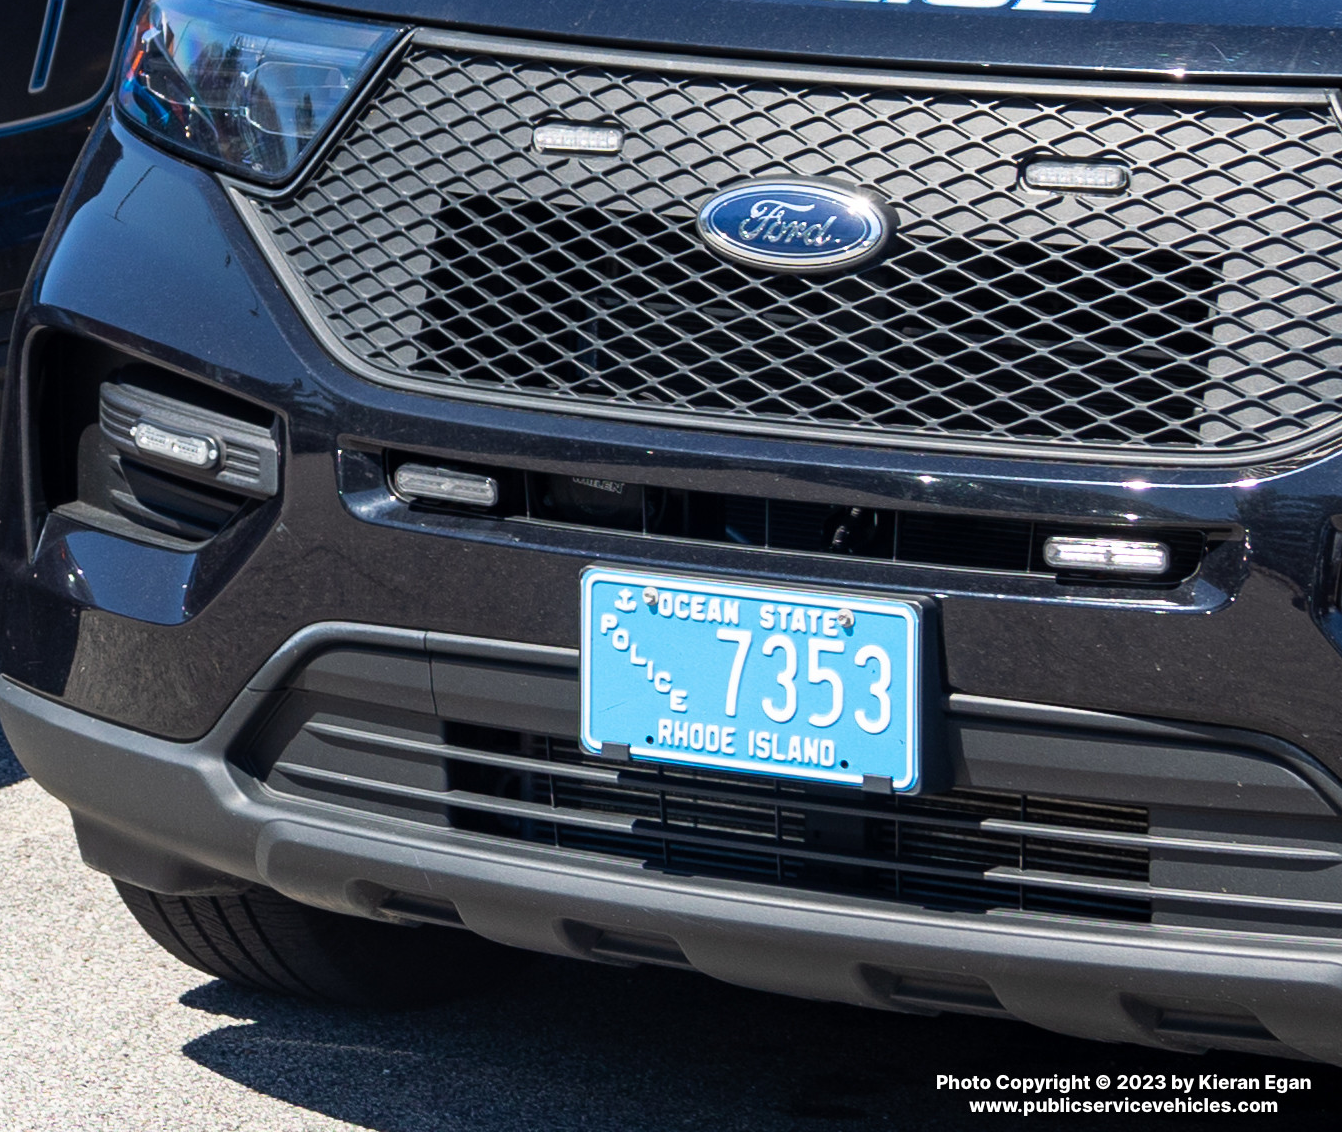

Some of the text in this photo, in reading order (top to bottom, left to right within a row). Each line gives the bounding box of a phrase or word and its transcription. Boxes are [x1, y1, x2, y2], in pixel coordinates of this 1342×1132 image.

[737, 199, 837, 246] Ford
[658, 593, 838, 636] OCEAN STATE
[600, 614, 687, 712] POLICE
[716, 629, 891, 734] 7353
[658, 718, 835, 766] RHODE ISLAND
